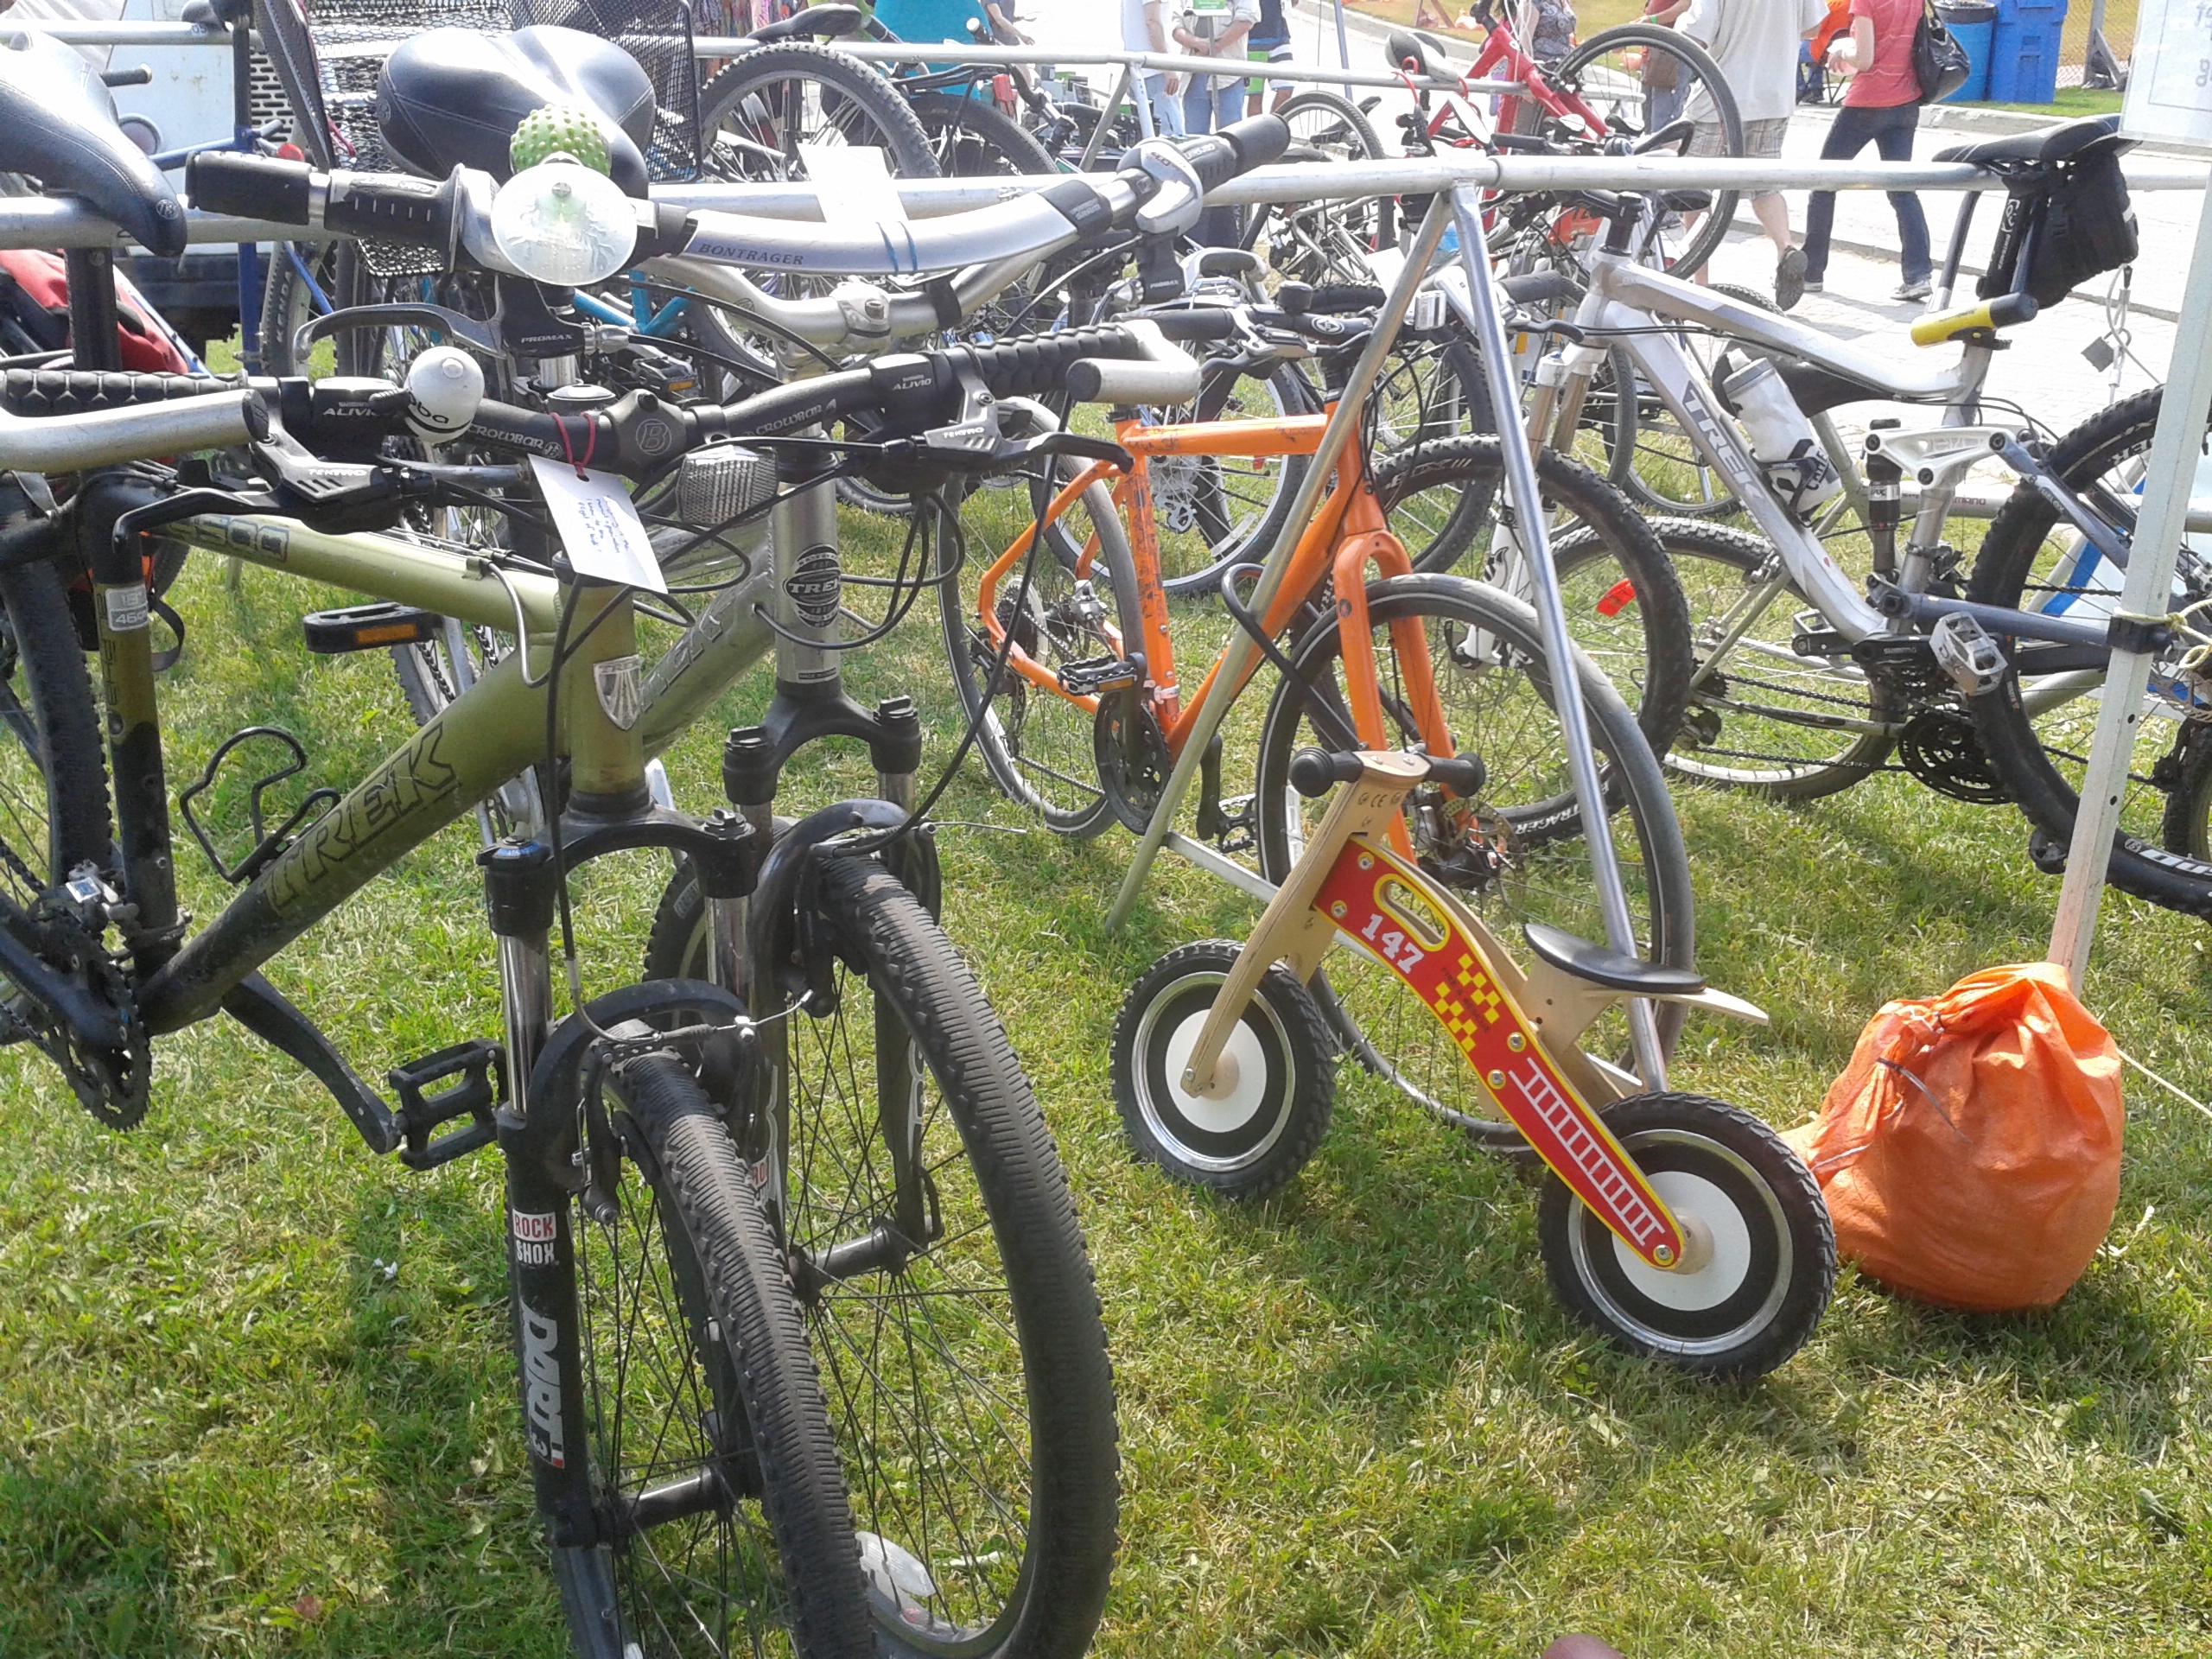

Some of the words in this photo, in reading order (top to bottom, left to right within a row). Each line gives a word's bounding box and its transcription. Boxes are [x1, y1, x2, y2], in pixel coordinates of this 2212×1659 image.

[698, 243, 804, 265] BONTRAGER
[276, 271, 291, 343] KENDA
[520, 334, 573, 344] PROMAX
[893, 378, 932, 390] ALIVIO
[322, 407, 378, 416] ALIVI
[1684, 384, 1766, 500] TREK
[308, 467, 367, 476] TEKTRO
[256, 721, 457, 912] TREK
[1361, 913, 1425, 974] 147
[515, 1213, 554, 1238] ROCK
[516, 1239, 555, 1264] SHOX
[520, 1298, 563, 1452] DART
